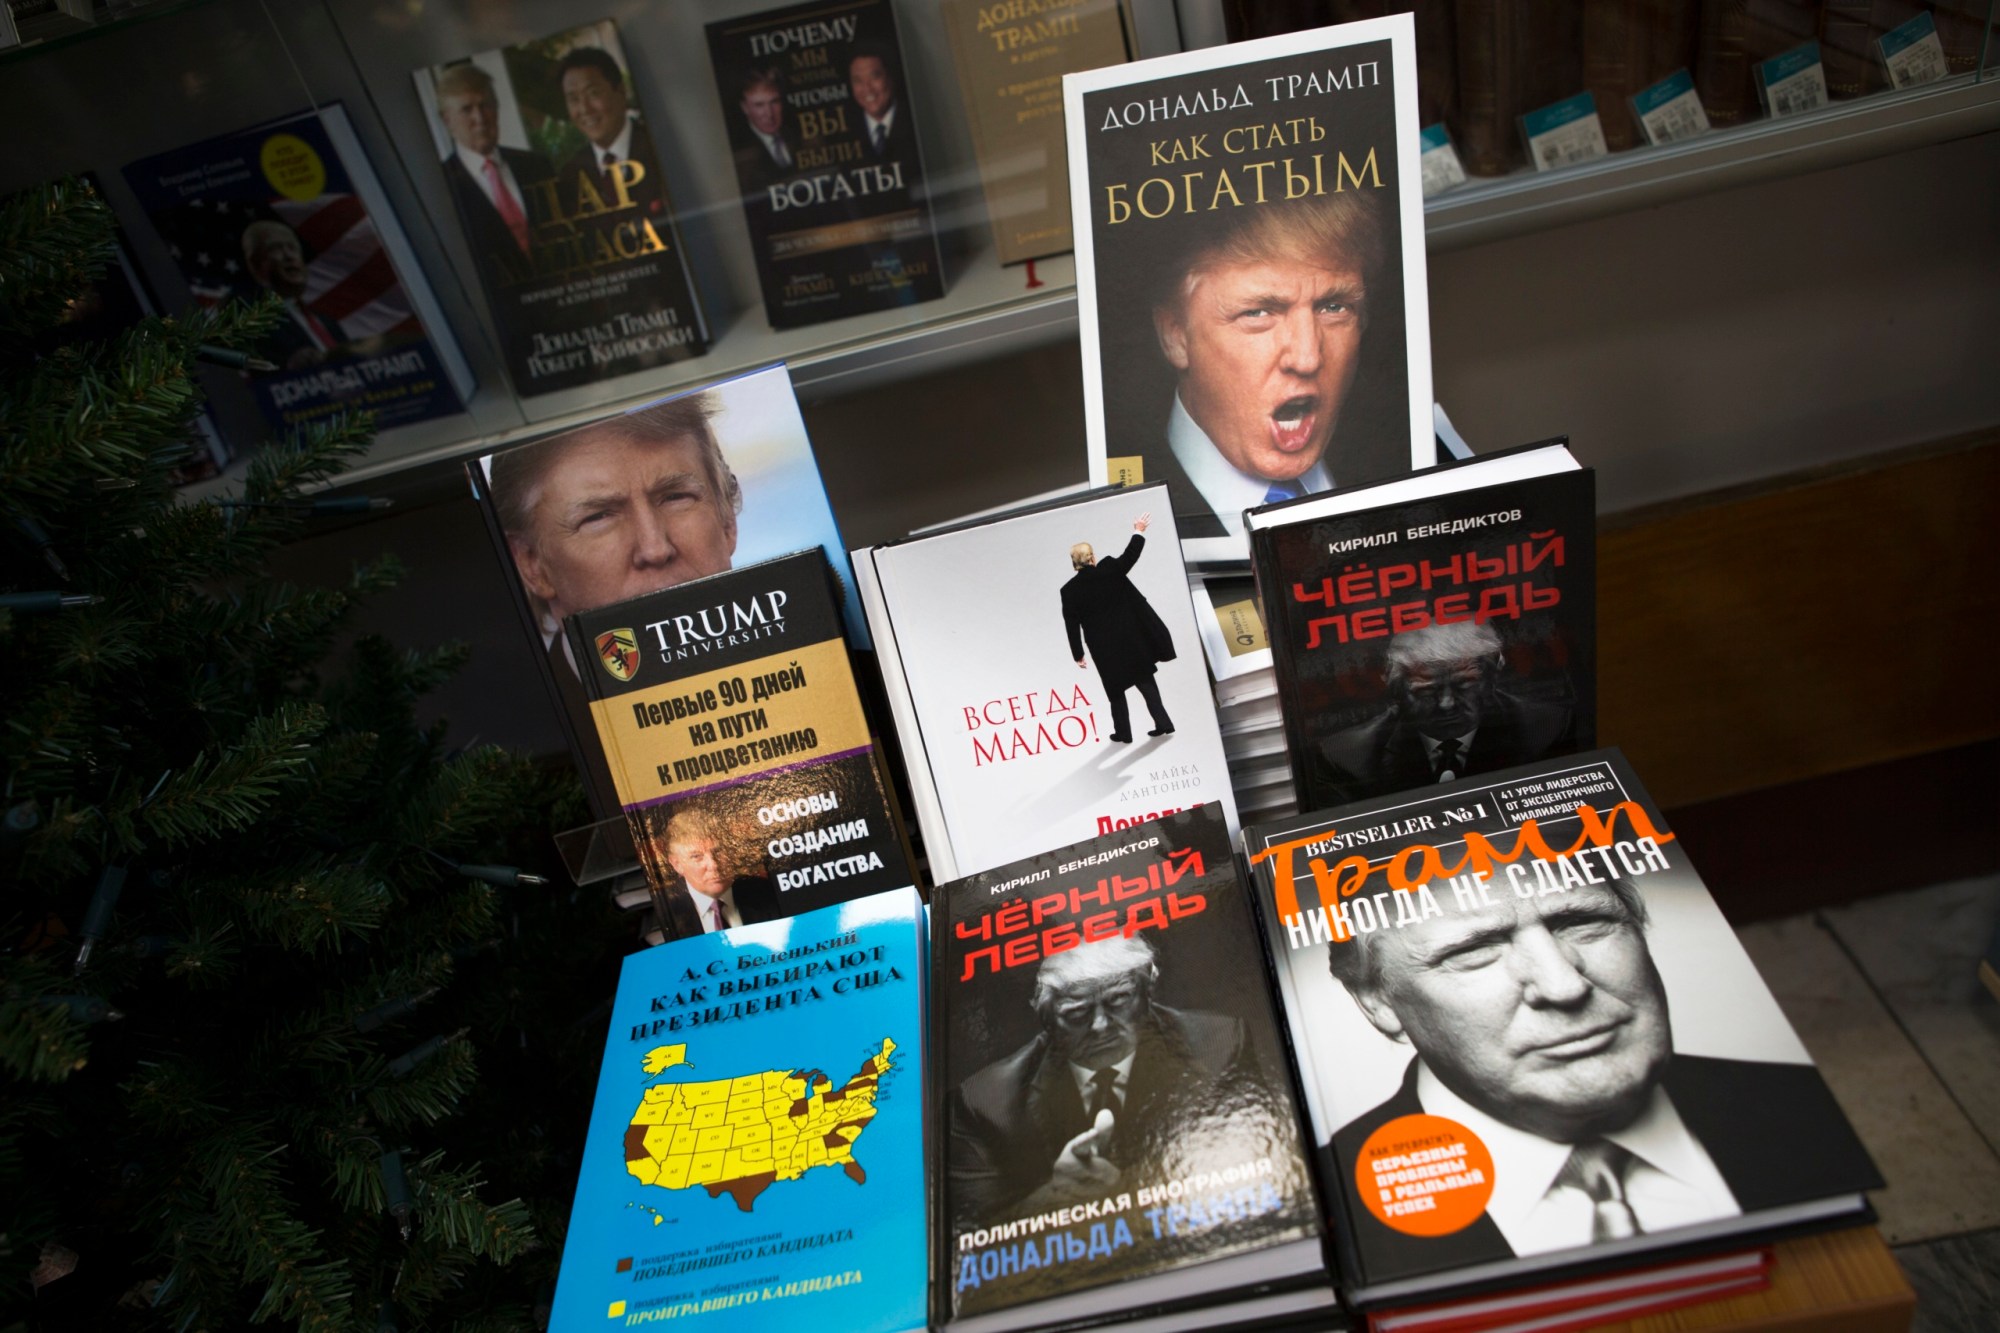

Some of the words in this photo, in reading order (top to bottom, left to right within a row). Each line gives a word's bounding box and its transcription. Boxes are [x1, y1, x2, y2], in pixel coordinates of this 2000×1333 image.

[750, 14, 857, 57] ПОЧЕМУ
[977, 0, 1088, 32] ДОНАЛ
[990, 13, 1080, 51] ТРАМП
[790, 47, 828, 69] МЫ
[787, 83, 849, 108] ЧТОБЫ
[1100, 84, 1253, 132] ДОНАЛЬД
[1265, 61, 1381, 101] ТРАМП
[798, 105, 848, 140] ВЫ
[1150, 134, 1213, 166] КАК
[1223, 117, 1326, 154] СТАТЬ
[795, 139, 864, 170] БЫЛИ
[767, 161, 906, 212] БОГАТЫ
[1104, 147, 1386, 224] БОГАТЫМ
[614, 307, 679, 336] ТРАМП
[268, 364, 367, 410] ДОНАЛЬД
[357, 350, 427, 383] ТРАМП
[1328, 532, 1398, 555] КИРИЛЛ
[1406, 508, 1522, 541] БЕНЕДИКТОВ
[1292, 528, 1565, 608] ЧЁРНЫЙ
[645, 589, 787, 652] TRUMP
[1306, 581, 1561, 649] ЛЕБЕДЬ
[660, 620, 787, 664] UNIVERSITY
[632, 687, 718, 729] Первые
[718, 676, 748, 704] 90
[751, 660, 807, 703] дней
[962, 684, 1093, 731] ВСЕГДА
[688, 723, 716, 748] на
[717, 707, 769, 743] пути
[972, 711, 1101, 767] МАЛО!
[656, 763, 673, 786] к
[672, 727, 819, 781] процветанию
[1149, 763, 1200, 783] МАЙКЛ
[757, 790, 838, 826] ОСНОВЫ
[1500, 789, 1513, 799] 41
[1515, 783, 1544, 796] УРОК
[1546, 771, 1606, 790] ЛИДЕРСТВА
[1505, 801, 1519, 811] ОТ
[1521, 781, 1615, 808] ЭКСЦЕНТРИЧНОГО
[1511, 800, 1587, 823] МИЛЛИАРДЕРА
[767, 818, 869, 859] СОЗДАНИЯ
[1305, 814, 1437, 859] BESTSELLER
[776, 851, 884, 892] БОГАТСТВА
[990, 869, 1051, 895] КИРИЛЛ
[1058, 837, 1160, 875] БЕНЕДИКТОВ
[1251, 800, 1675, 942] Трамп
[955, 847, 1206, 941] ЧЁРНЫЙ
[1284, 885, 1441, 949] НИКОГДА
[1449, 871, 1500, 912] НЕ
[1506, 836, 1671, 898] СДАЕТСЯ
[737, 930, 858, 970] Беленький
[960, 892, 1207, 982] ЛЕБЕДЬ
[650, 985, 708, 1014] КАК
[718, 945, 885, 998] ВЫБИРАЮТ
[629, 985, 822, 1042] ПРЕЗИДЕНТА
[832, 966, 902, 994] США
[1371, 1143, 1467, 1173] СЕРЬЕЗНЫЕ
[1375, 1158, 1467, 1187] ПРОБЛЕМЫ
[959, 1193, 1132, 1251] ПОЛИТИЧЕСКАЯ
[1136, 1157, 1273, 1208] БИОГРАФИЯ
[1379, 1189, 1392, 1203] В
[1394, 1168, 1485, 1199] РЕАЛЬНЫЙ
[1383, 1195, 1436, 1218] УСПЕХ
[632, 1248, 754, 1282] ПОБЕДИВШЕГО
[756, 1228, 853, 1258] КАНДИДАТА
[955, 1218, 1134, 1293] ДОНАЛЬДА
[1143, 1182, 1283, 1240] ТРАМПА
[625, 1290, 759, 1327] ПРОИГРАВШЕГО
[761, 1270, 863, 1301] КАНДИДАТА
